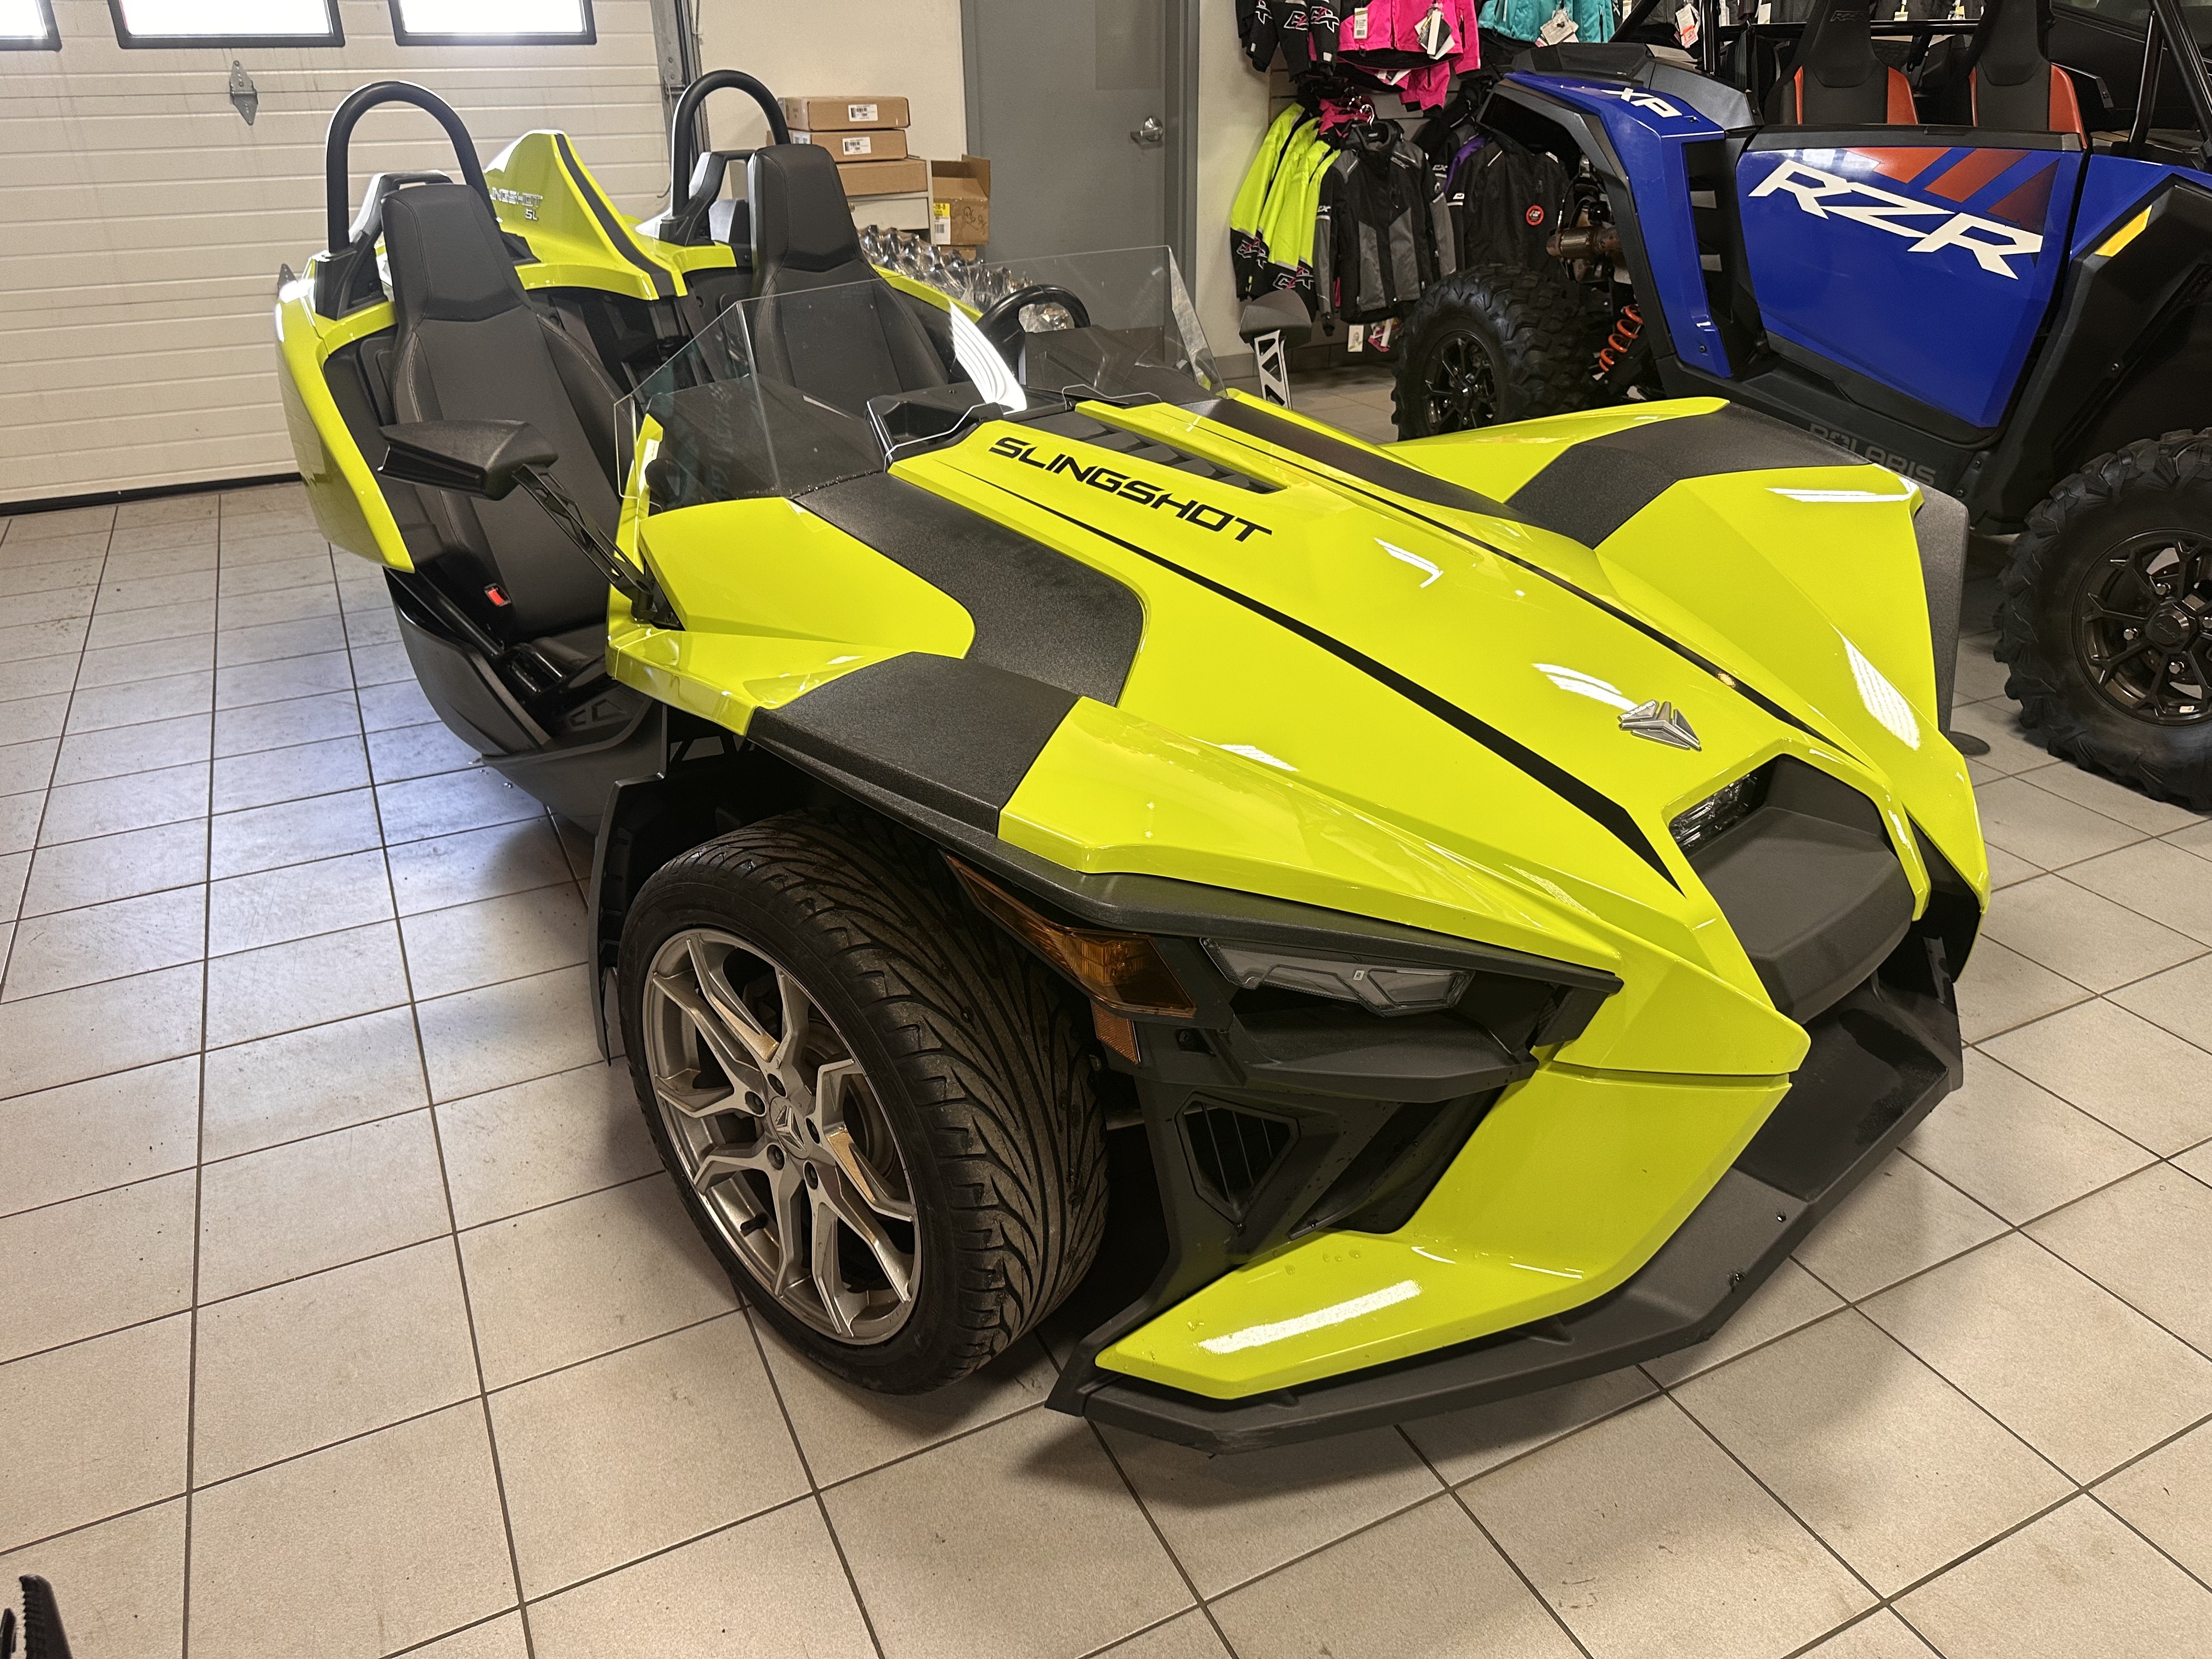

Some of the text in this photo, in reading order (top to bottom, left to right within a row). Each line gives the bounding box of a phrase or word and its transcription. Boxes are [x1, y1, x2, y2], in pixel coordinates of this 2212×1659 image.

[1601, 87, 1683, 118] XP
[525, 208, 539, 221] SL
[1748, 159, 2044, 280] RZR
[988, 437, 1273, 543] SLINGSHOT
